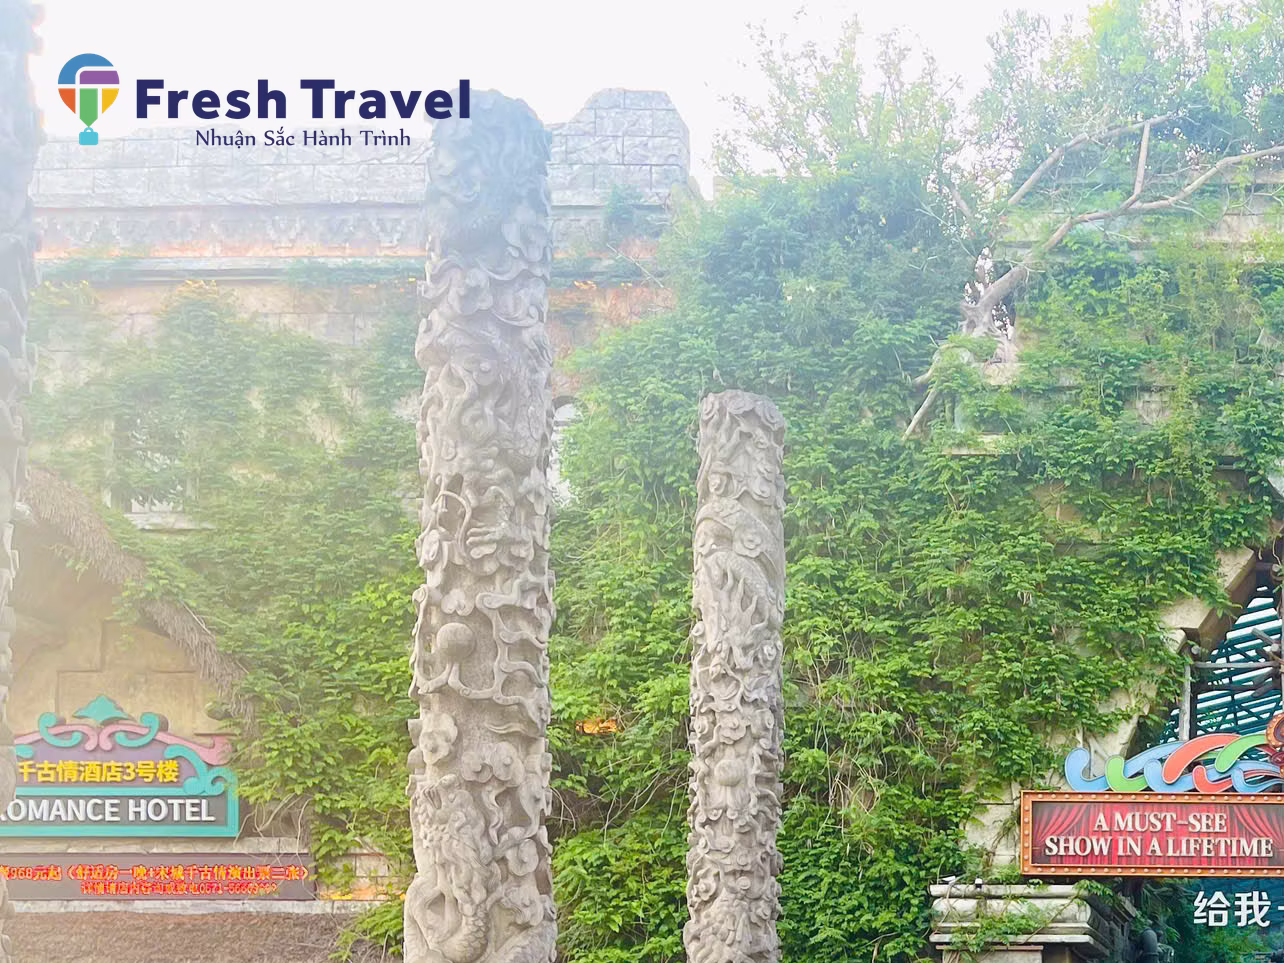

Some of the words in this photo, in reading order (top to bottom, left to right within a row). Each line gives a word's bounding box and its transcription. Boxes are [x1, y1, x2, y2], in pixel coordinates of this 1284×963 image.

[18, 759, 179, 783] 千古情酒店3号楼
[0, 798, 120, 822] OMANCE
[128, 798, 216, 822] HOTEL
[1093, 813, 1110, 832] A
[1113, 812, 1227, 833] MUST-SEE
[1045, 836, 1112, 856] SHOW
[1117, 836, 1143, 857] IN
[1147, 837, 1164, 856] A
[1167, 837, 1274, 858] LIFETIME
